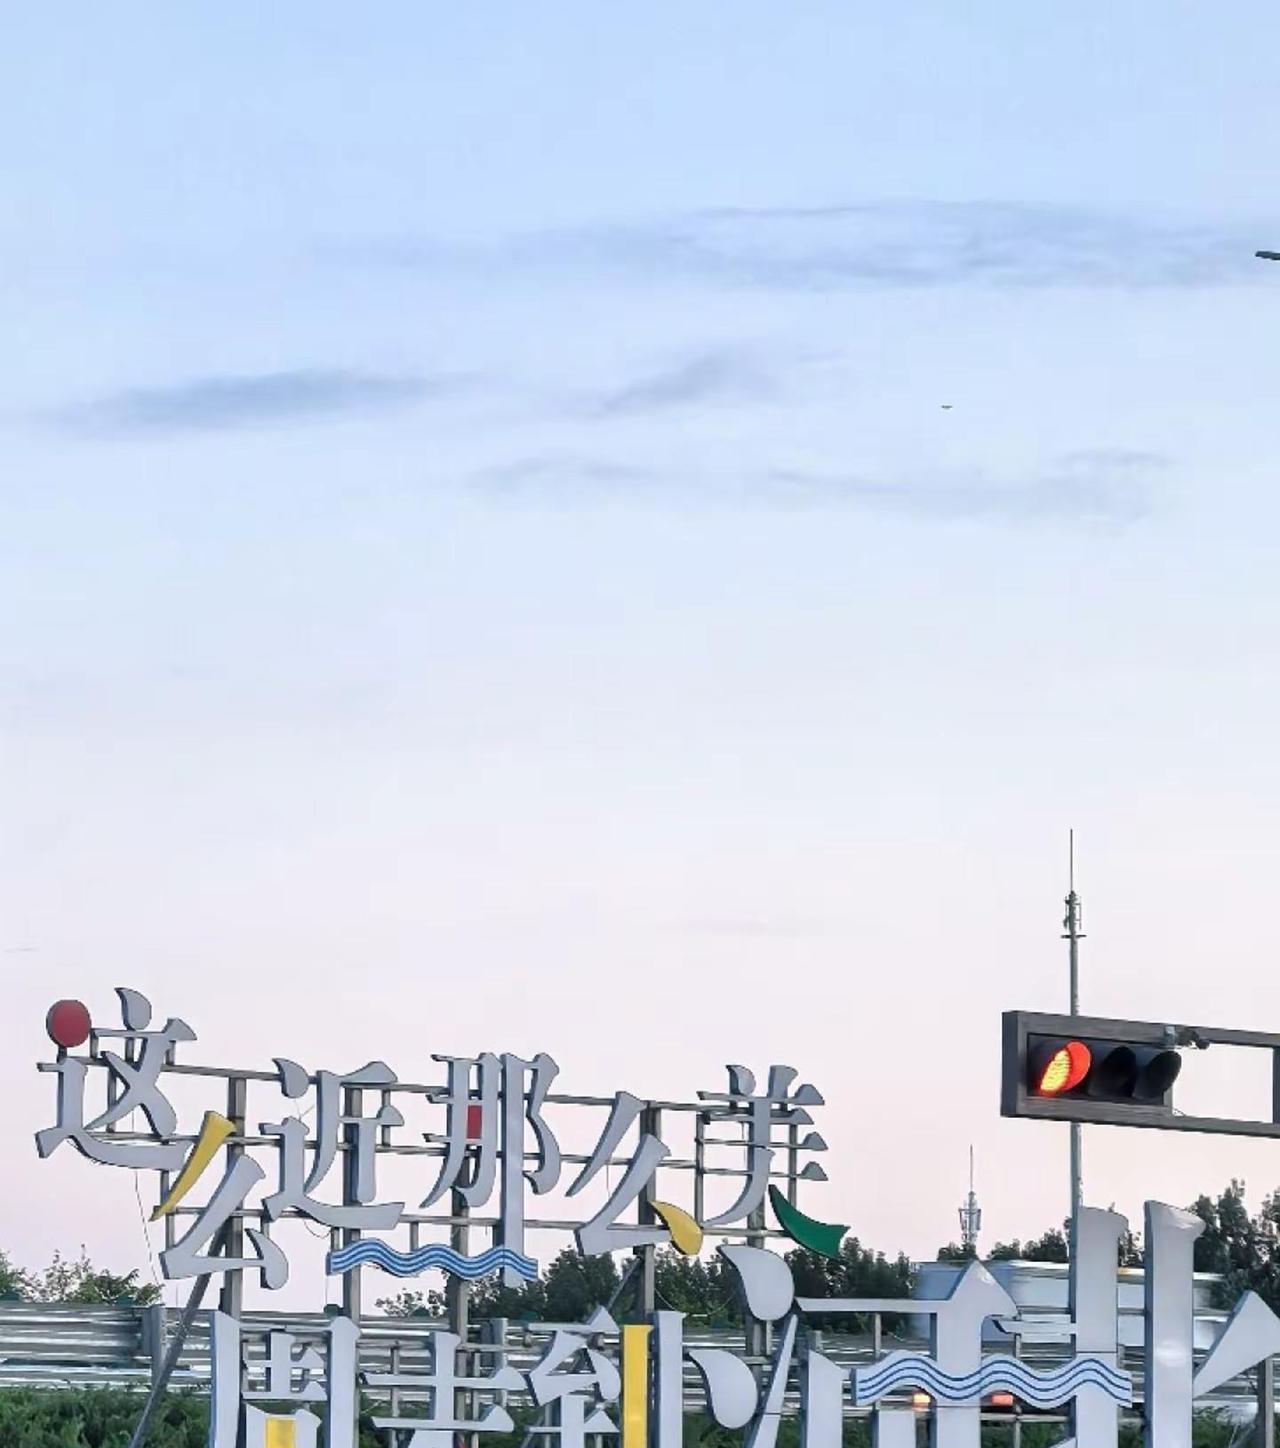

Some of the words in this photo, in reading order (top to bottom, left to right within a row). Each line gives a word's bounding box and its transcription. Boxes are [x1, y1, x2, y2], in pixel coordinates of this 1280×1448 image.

[35, 986, 851, 1290] 这么近那么美
